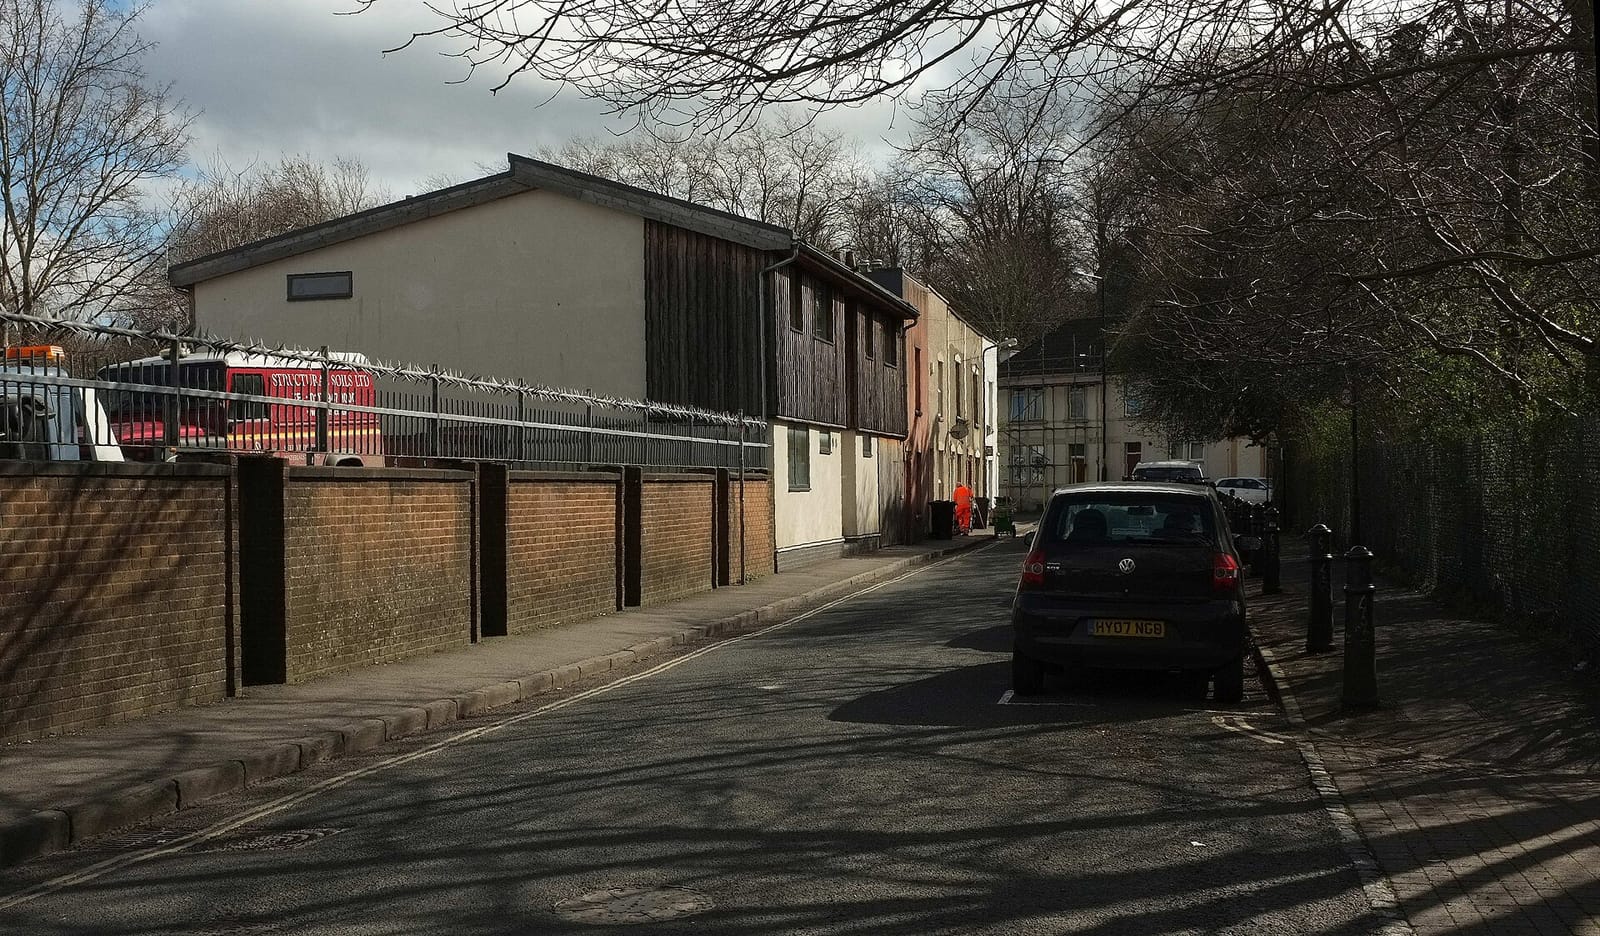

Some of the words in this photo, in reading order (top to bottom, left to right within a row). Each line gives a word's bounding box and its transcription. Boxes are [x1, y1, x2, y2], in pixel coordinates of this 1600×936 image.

[330, 374, 353, 387] SOILS
[355, 374, 370, 388] LTD
[1096, 621, 1131, 634] HY07
